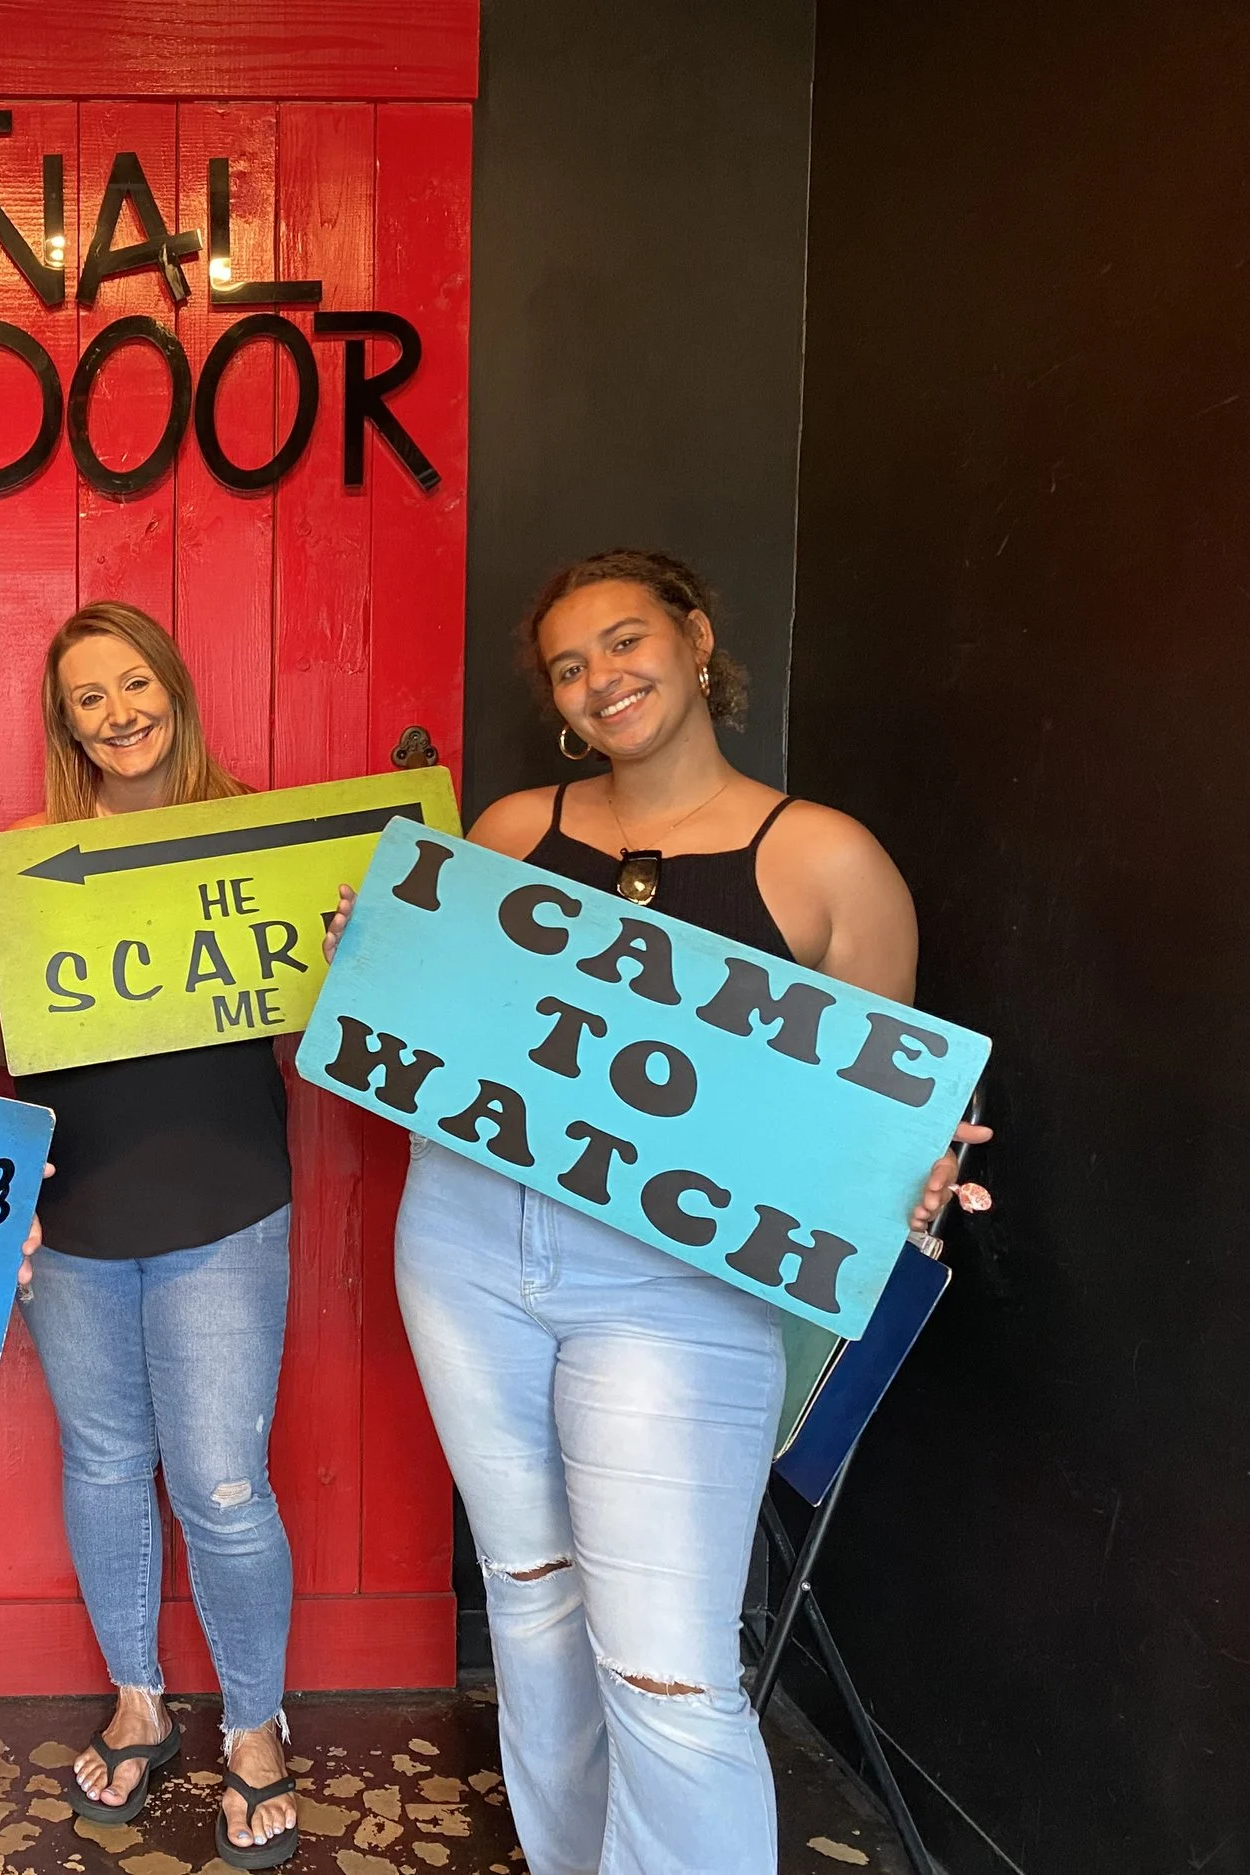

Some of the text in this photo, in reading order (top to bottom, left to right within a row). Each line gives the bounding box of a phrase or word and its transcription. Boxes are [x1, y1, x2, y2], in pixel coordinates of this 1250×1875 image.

[198, 877, 260, 920] HE
[45, 910, 338, 1013] SCAR
[212, 987, 286, 1033] ME
[392, 839, 949, 1108] I CAME
[528, 996, 699, 1118] TO
[324, 1015, 858, 1314] WATCH
